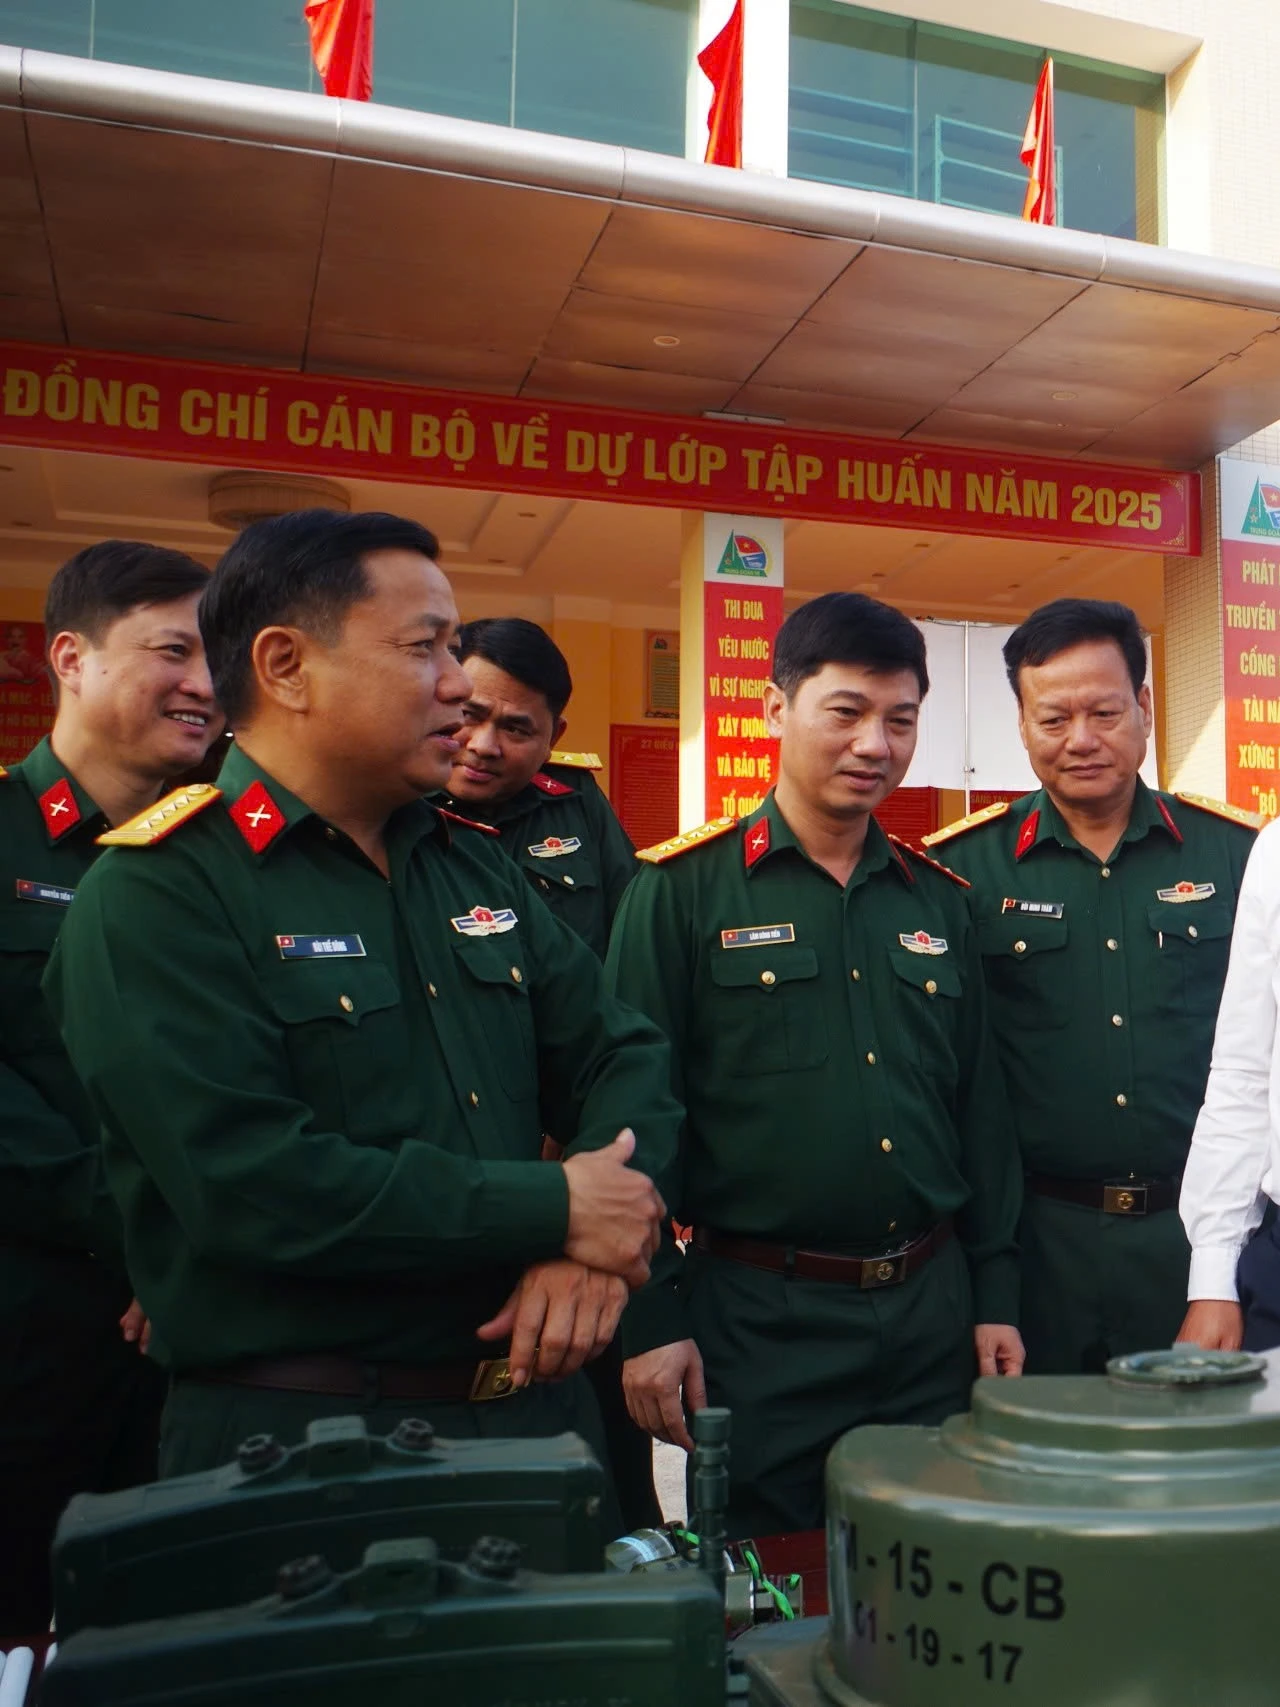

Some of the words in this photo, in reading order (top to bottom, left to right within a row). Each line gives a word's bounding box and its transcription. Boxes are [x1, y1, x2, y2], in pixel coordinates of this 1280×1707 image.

[3, 358, 161, 431] ĐỒNG
[179, 386, 269, 441] CHÍ
[287, 394, 394, 454] CÁN
[411, 408, 476, 472] BỘ
[492, 411, 550, 469] VỀ
[566, 430, 634, 486] DỰ
[643, 432, 728, 485] LỚP
[742, 444, 824, 502] TẬP
[839, 453, 952, 511] HUẤN
[966, 469, 1058, 521] NĂM
[1071, 485, 1163, 531] 2025
[1242, 557, 1275, 586] PHÁT
[724, 598, 741, 620] THI
[743, 600, 764, 621] ĐUA
[1226, 601, 1276, 632] TRUYỀN
[718, 633, 739, 659] YÊU
[741, 635, 769, 661] NƯỚC
[1240, 647, 1276, 678] CỐNG
[709, 672, 720, 697] VÌ
[723, 677, 738, 703] SỰ
[1243, 698, 1265, 723] TÀI
[718, 714, 738, 738] XÂY
[717, 753, 733, 777] VÀ
[735, 753, 756, 778] BẢO
[757, 754, 771, 783] VỆ
[1238, 744, 1276, 771] XỨNG
[722, 788, 736, 818] TỔ
[889, 1540, 933, 1599] 15
[981, 1561, 1066, 1622] CB
[906, 1623, 940, 1667] 19
[977, 1640, 1024, 1685] 17
